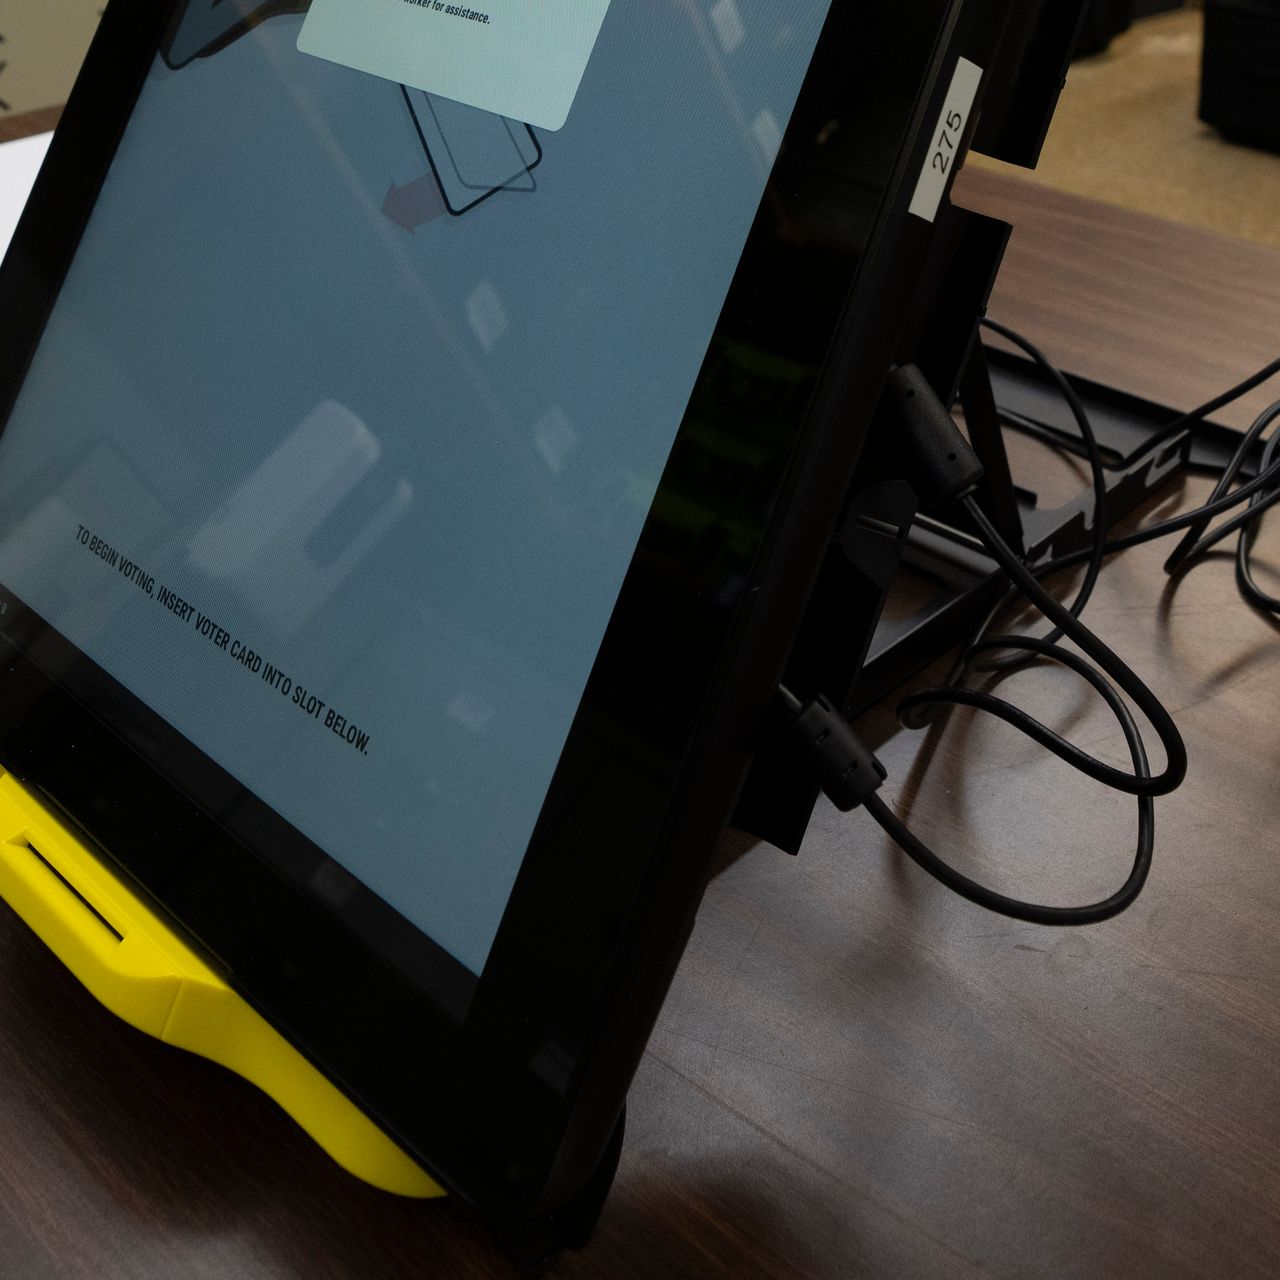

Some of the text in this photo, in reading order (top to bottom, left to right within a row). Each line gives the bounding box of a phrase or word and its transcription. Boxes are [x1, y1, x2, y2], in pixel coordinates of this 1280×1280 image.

[432, 0, 444, 13] for
[445, 5, 491, 25] assistance.
[932, 109, 962, 175] 275
[75, 524, 370, 756] TO BEGIN VOTING, INSERT VOTER CARD INTO SLOT BELOW.
